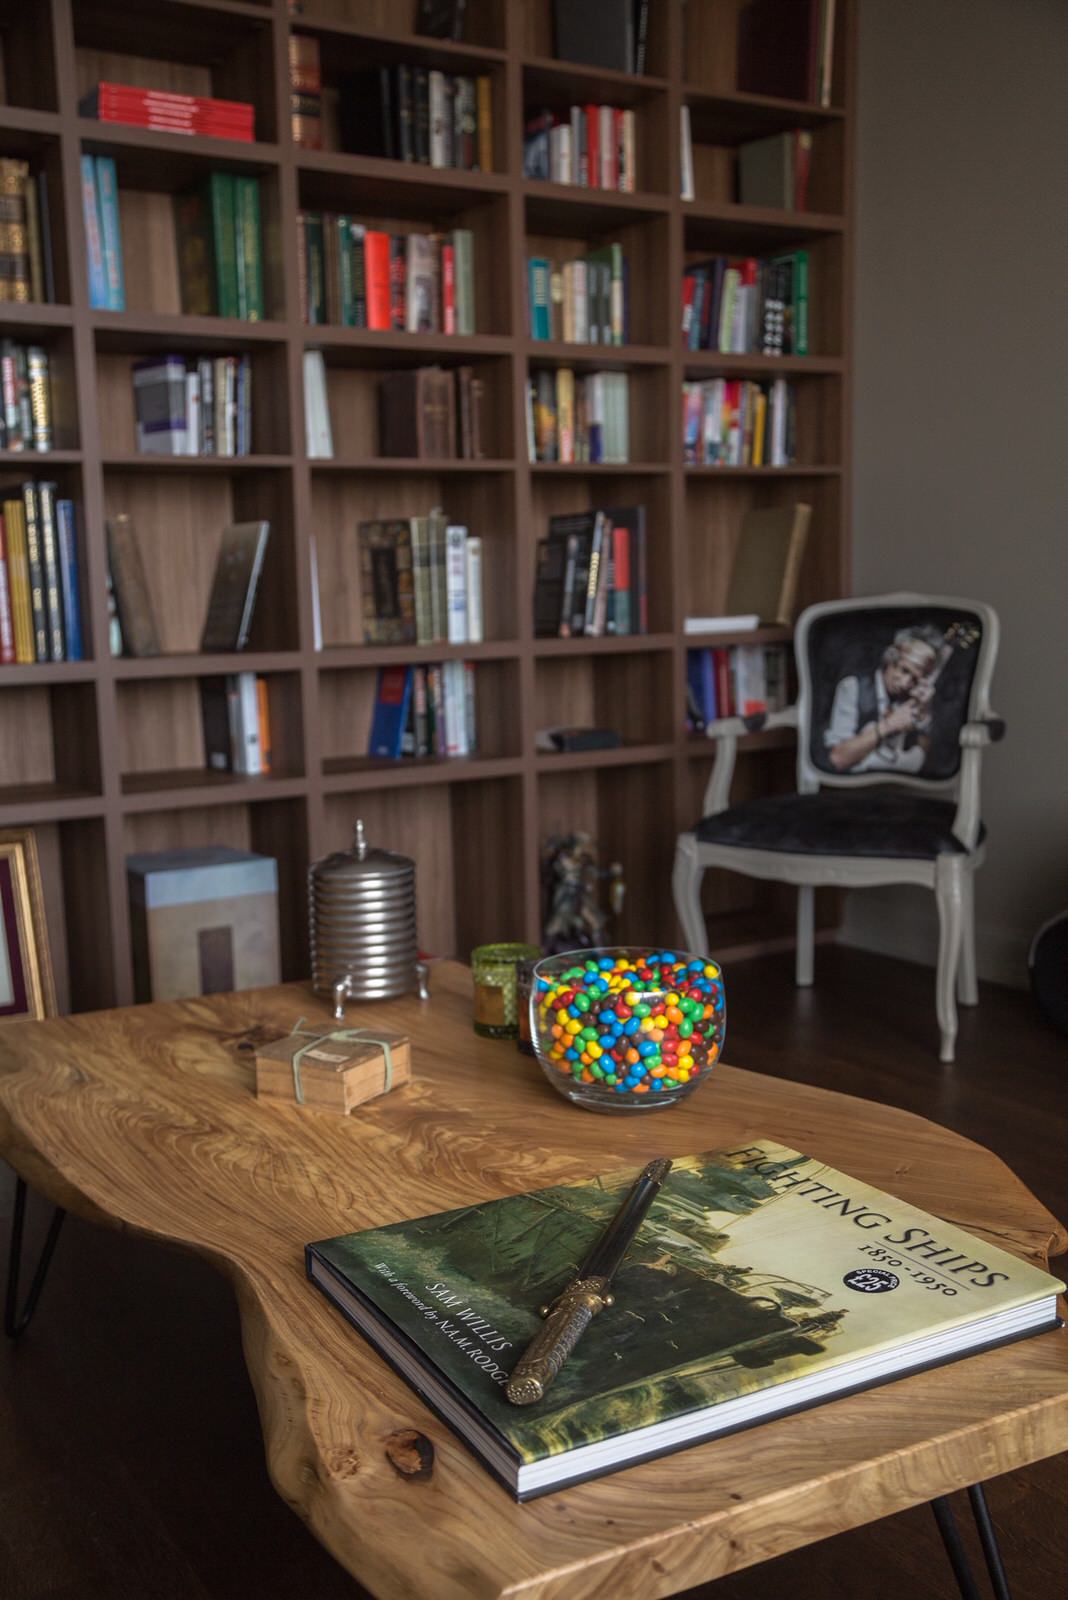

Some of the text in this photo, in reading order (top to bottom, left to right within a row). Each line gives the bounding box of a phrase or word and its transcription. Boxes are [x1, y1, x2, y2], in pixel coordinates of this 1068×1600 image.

[726, 1147, 1010, 1288] FIGHTING SHIPS
[374, 1262, 396, 1277] With
[390, 1283, 432, 1310] foreword
[424, 1311, 438, 1319] by
[848, 1274, 888, 1291] £25
[425, 1283, 512, 1351] SAM WILLIS
